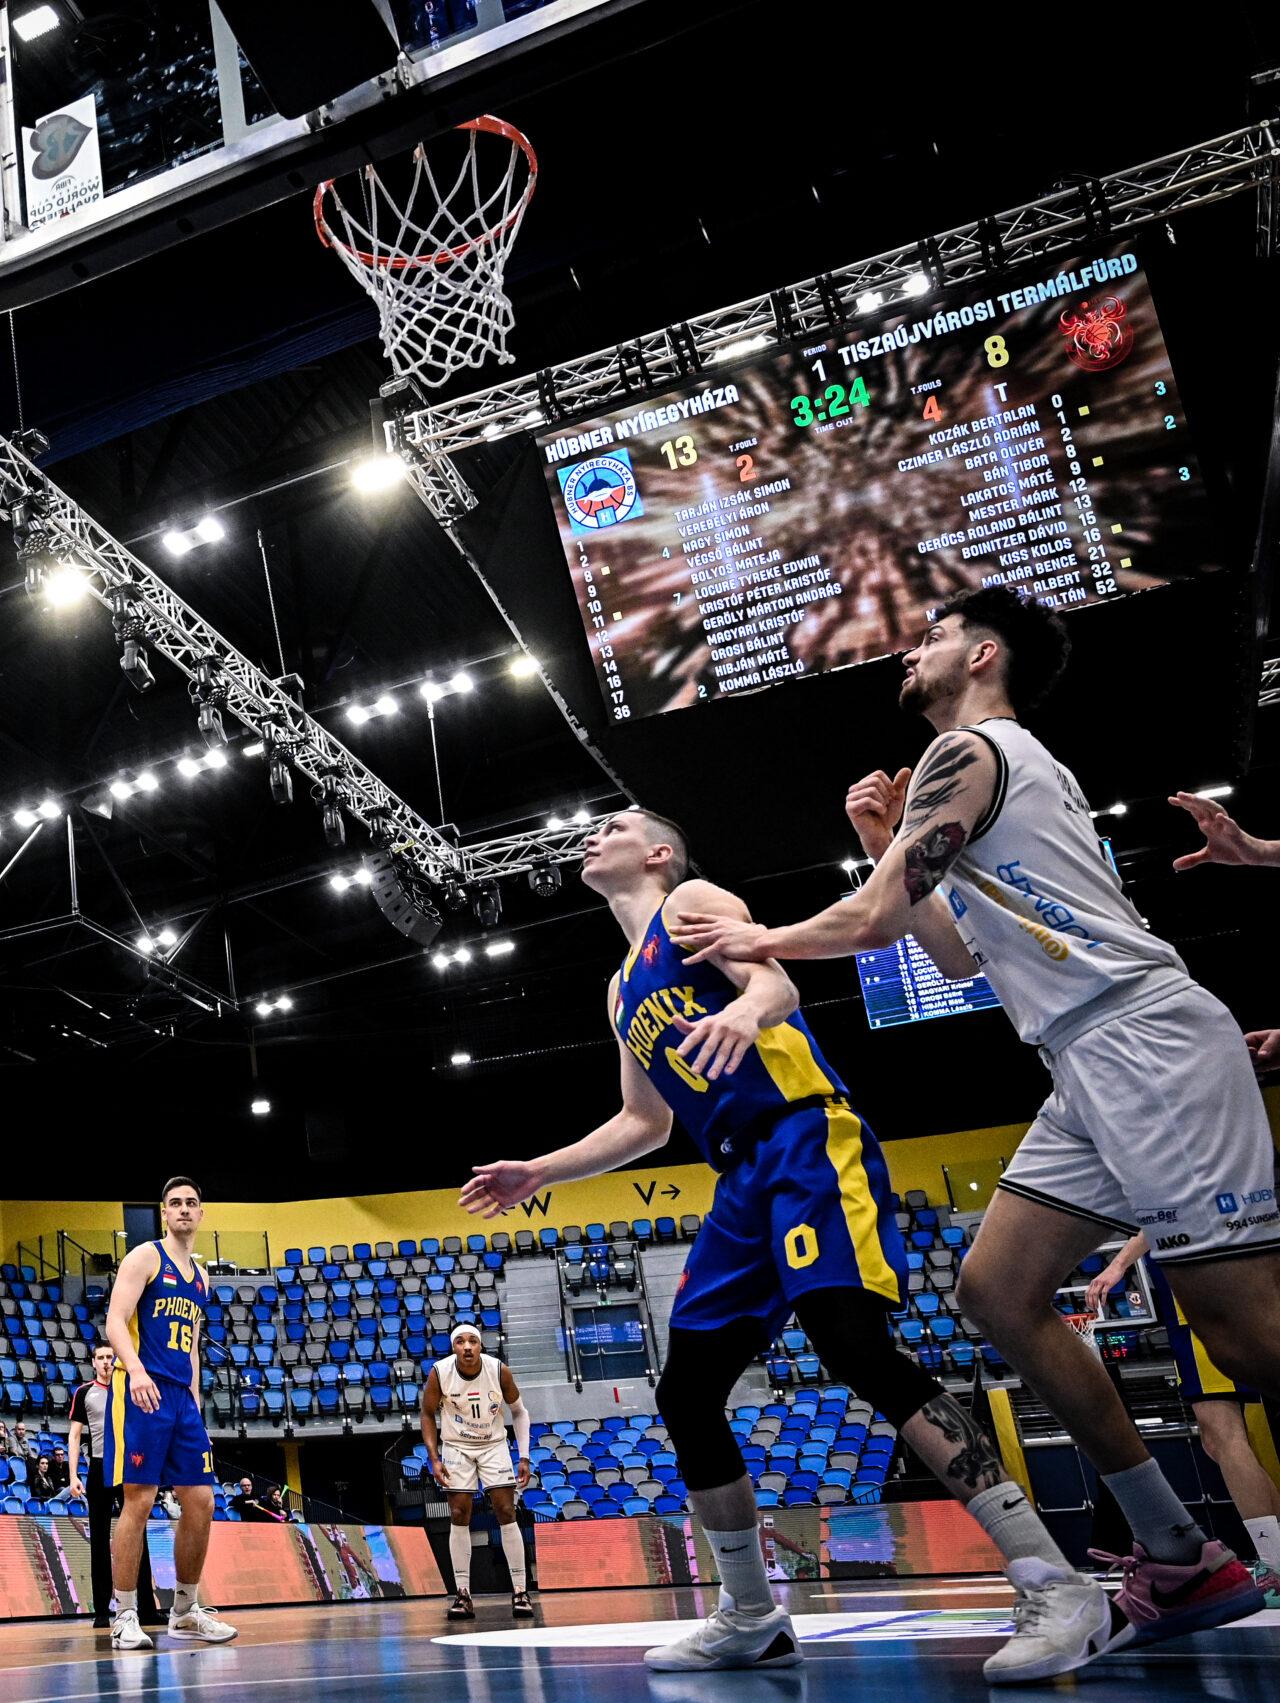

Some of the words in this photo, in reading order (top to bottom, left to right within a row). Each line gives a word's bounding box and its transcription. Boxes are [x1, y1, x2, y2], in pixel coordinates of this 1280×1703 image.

[802, 343, 827, 357] PERIOD
[838, 299, 994, 365] TISZAÚJVÁROSI
[984, 335, 1010, 368] 8
[811, 360, 826, 382] 1
[910, 378, 942, 395] T.FOULS
[994, 382, 1008, 402] T
[545, 426, 613, 463] HÜBNER
[616, 384, 739, 439] NYÍREGYHÁZA
[791, 376, 871, 427] 3:24
[922, 395, 942, 422] 4
[928, 422, 970, 445] KOZÁK
[971, 404, 1036, 432] BERTALAN
[729, 438, 757, 453] T.FOULS
[814, 422, 835, 434] TIME
[835, 416, 854, 428] OUT
[898, 449, 943, 472] CZIMER
[945, 434, 991, 458] LÁSZLÓ
[993, 419, 1041, 444] ADRIÁN
[1057, 411, 1067, 425] 1
[1154, 381, 1167, 396] 3
[983, 464, 1010, 482] BÁN
[1012, 454, 1049, 474] TIBOR
[1064, 444, 1077, 459] 8
[1163, 414, 1177, 430] 2
[660, 436, 698, 470] 13
[736, 454, 757, 482] 2
[965, 451, 998, 470] BATA
[1000, 436, 1045, 459] OLIVÉR
[1060, 427, 1072, 442] 2
[960, 481, 1016, 507] LAKATOS
[1018, 469, 1054, 490] MÁTÉ
[1069, 461, 1082, 476] 9
[968, 517, 1017, 540] ROLAND
[1018, 503, 1063, 526] BÁLINT
[1073, 493, 1093, 510] 13
[1178, 466, 1191, 482] 3
[969, 499, 1020, 522] MESTER
[1021, 486, 1059, 507] MÁRK
[1068, 477, 1088, 494] 12
[576, 540, 584, 552] 1
[674, 500, 717, 522] TARJÁN
[718, 489, 753, 509] IZSÁK
[754, 479, 791, 499] SIMON
[579, 554, 589, 568] 2
[678, 510, 738, 538] VEREBÉLYI
[738, 501, 770, 520] ÁRON
[962, 532, 1026, 559] BOINITZER
[1028, 519, 1068, 541] DÁVID
[1077, 511, 1097, 527] 15
[583, 570, 593, 583] 8
[660, 547, 671, 559] 4
[683, 536, 712, 553] NAGY
[714, 525, 750, 544] SIMON
[586, 585, 597, 598] 9
[724, 536, 764, 557] BÁLINT
[981, 564, 1034, 590] MOLNÁR
[1035, 554, 1078, 575] BENCE
[1087, 544, 1106, 561] 21
[1000, 549, 1030, 567] KISS
[1031, 537, 1073, 558] KOLOS
[1082, 528, 1102, 544] 16
[586, 599, 602, 614] 10
[690, 563, 734, 584] BOLYOS
[735, 550, 781, 571] MATEJA
[591, 615, 605, 628] 11
[672, 592, 682, 605] 7
[694, 579, 737, 599] LOCURE
[738, 566, 782, 587] TYREKE
[783, 555, 820, 575] EDWIN
[1033, 571, 1082, 593] ALBERT
[1089, 561, 1113, 578] 32
[1094, 578, 1117, 595] 52
[595, 630, 610, 644] 12
[698, 592, 745, 615] KRISTÓF
[746, 582, 782, 601] PÉTER
[783, 568, 832, 591] KRISTÓF
[599, 645, 613, 659] 13
[746, 595, 794, 618] MÁRTON
[794, 582, 842, 605] ANDRÁS
[602, 660, 617, 674] 14
[706, 623, 757, 646] MAGYARI
[758, 609, 806, 631] KRISTÓF
[606, 675, 621, 689] 16
[710, 643, 745, 661] OROSI
[745, 631, 785, 651] BÁLINT
[610, 690, 625, 704] 17
[714, 656, 755, 677] HIBJÁN
[757, 647, 789, 665] MÁTÉ
[613, 704, 631, 720] 36
[697, 685, 707, 698] 2
[718, 672, 761, 692] KOMMA
[762, 660, 804, 681] LÁSZLÓ
[626, 986, 707, 1070] HOENIX
[521, 1191, 552, 1218] W
[633, 1181, 656, 1206] V
[784, 1223, 820, 1270] 0
[167, 1322, 193, 1353] 16
[472, 1404, 480, 1418] 11
